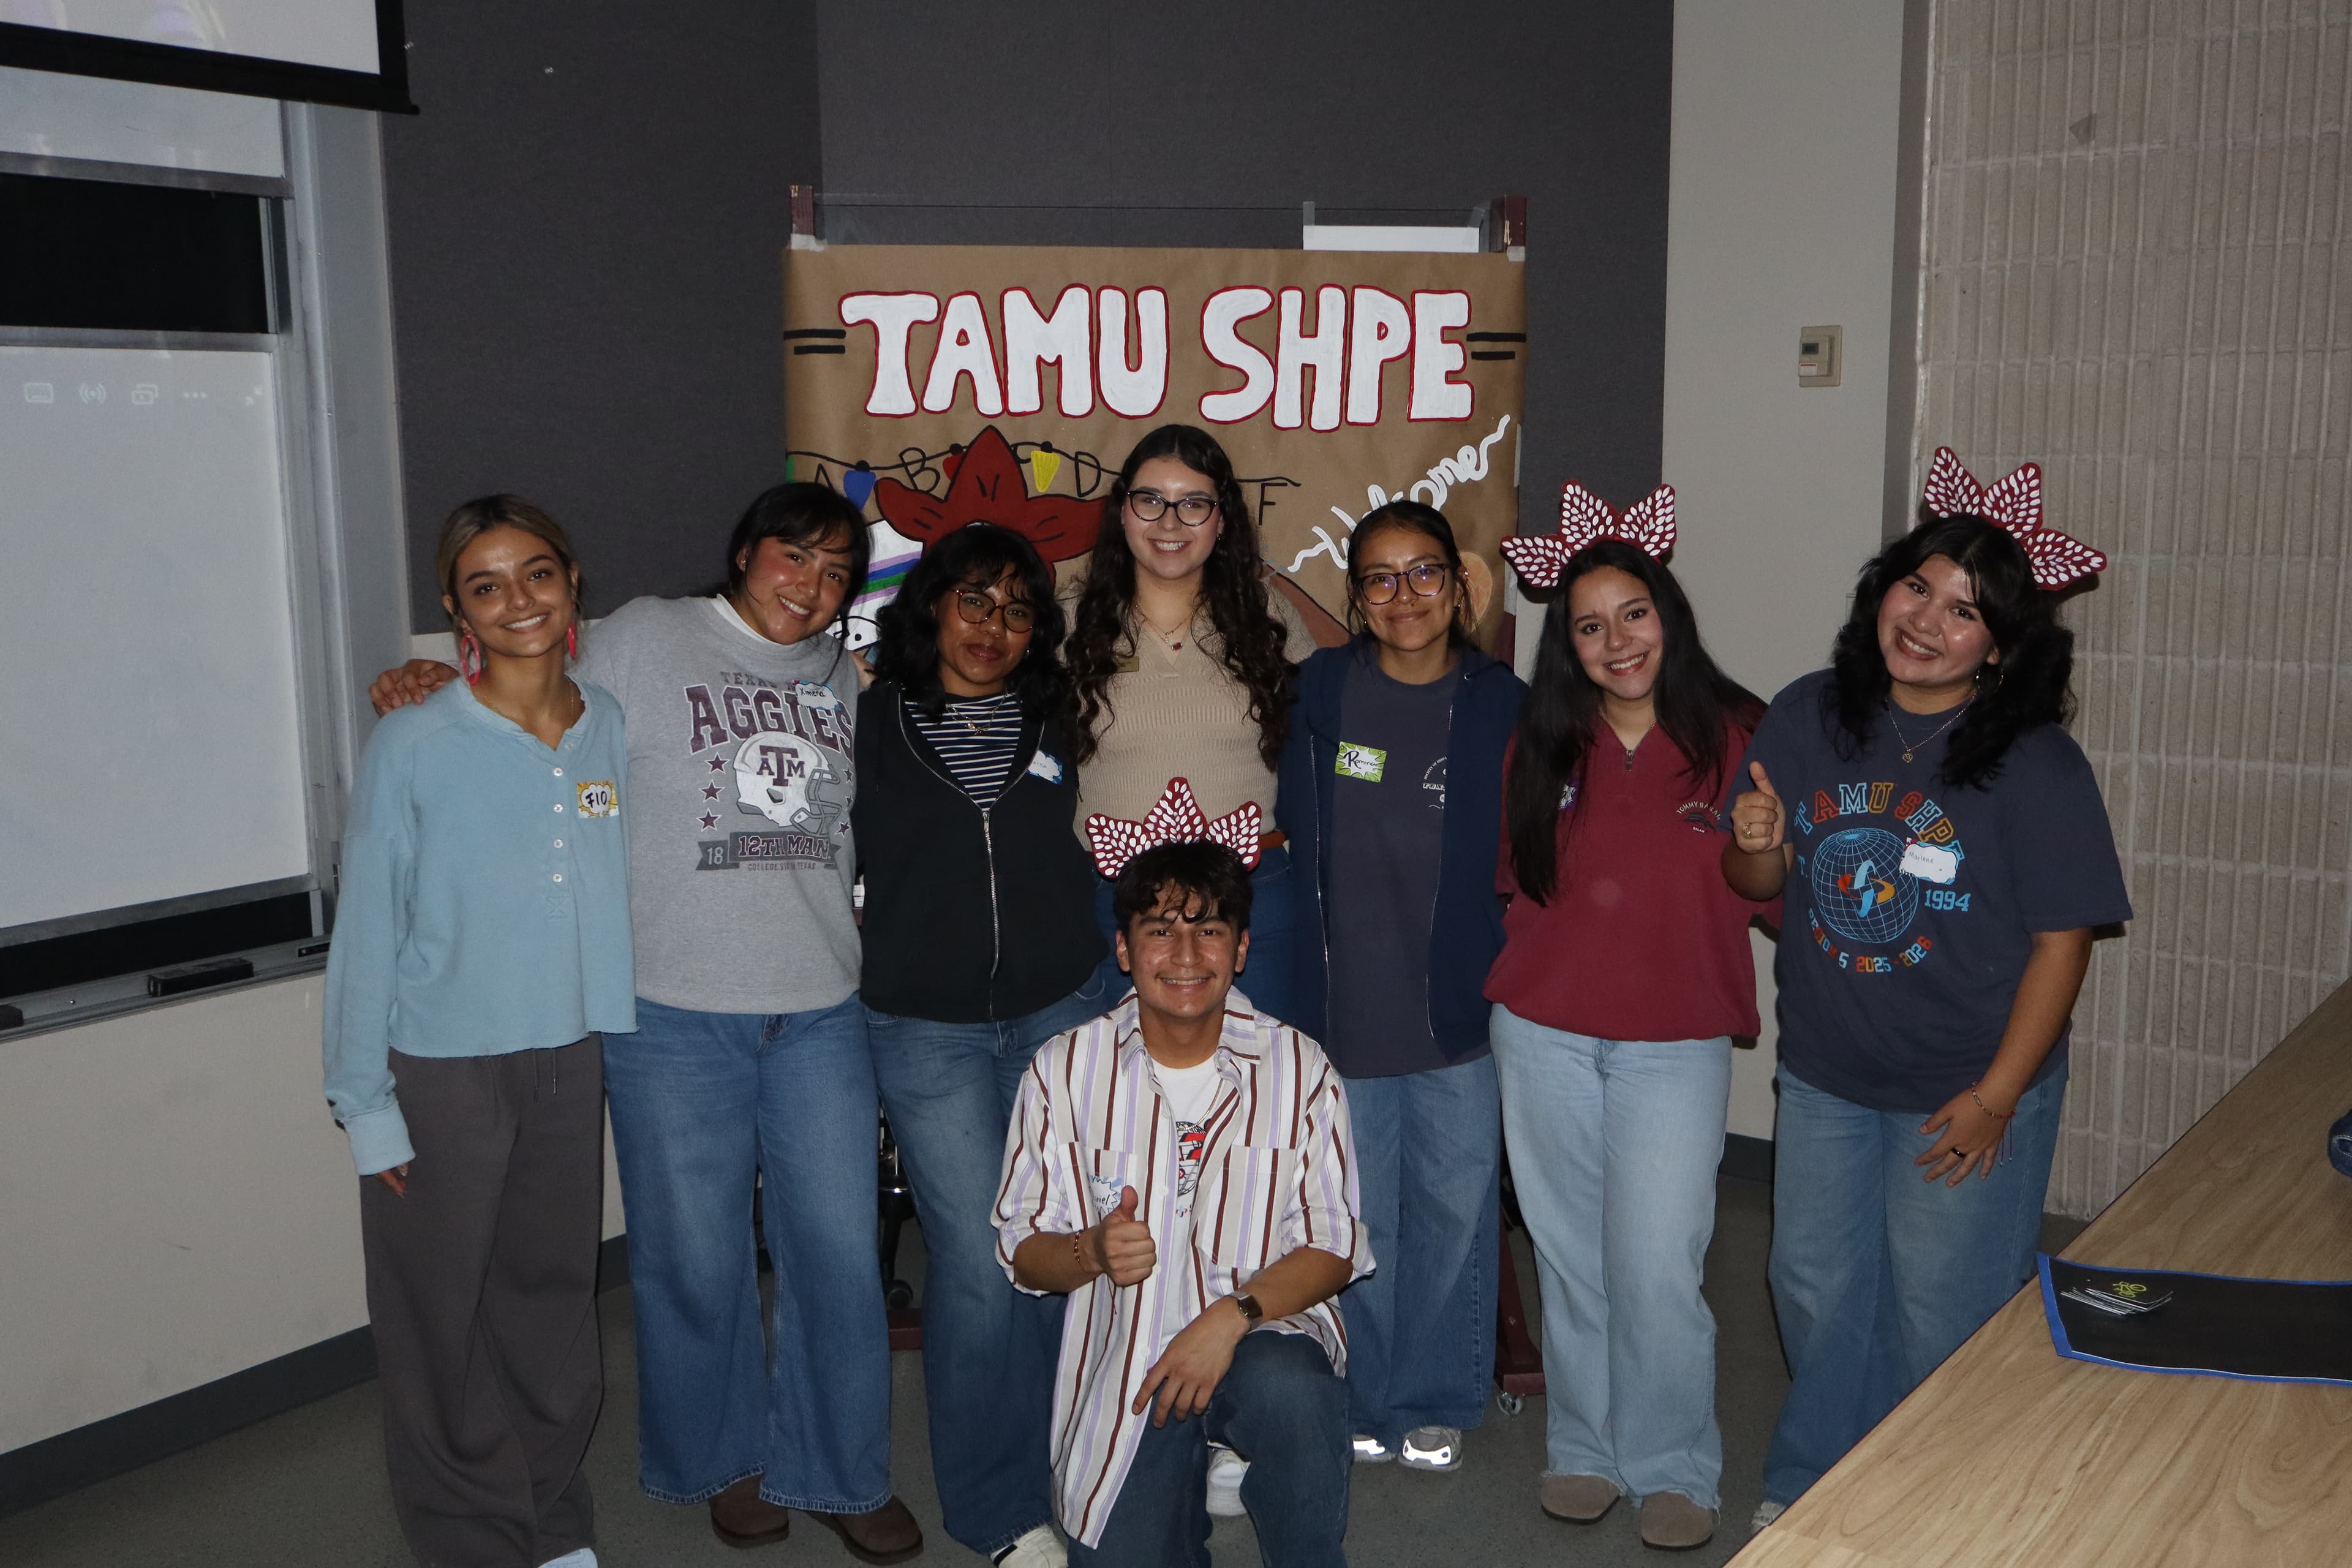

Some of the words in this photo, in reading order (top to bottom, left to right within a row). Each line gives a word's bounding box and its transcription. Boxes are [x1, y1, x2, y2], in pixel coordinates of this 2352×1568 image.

[839, 283, 1170, 419] TAMU
[1199, 284, 1475, 431] SHPE
[899, 447, 941, 492] B
[1075, 451, 1101, 497] D
[1258, 483, 1288, 526] F
[799, 687, 826, 697] Ximena
[684, 683, 854, 764] AGGIES
[1676, 801, 1698, 814] TOMMY
[1793, 782, 1896, 835] TAMU
[707, 846, 724, 865] 18
[738, 835, 786, 857] 12TH
[1909, 852, 1934, 864] Marlene
[1924, 889, 1972, 912] 1994
[1838, 951, 1849, 969] 5
[1856, 956, 1892, 973] 2025
[1899, 935, 1933, 967] 2026
